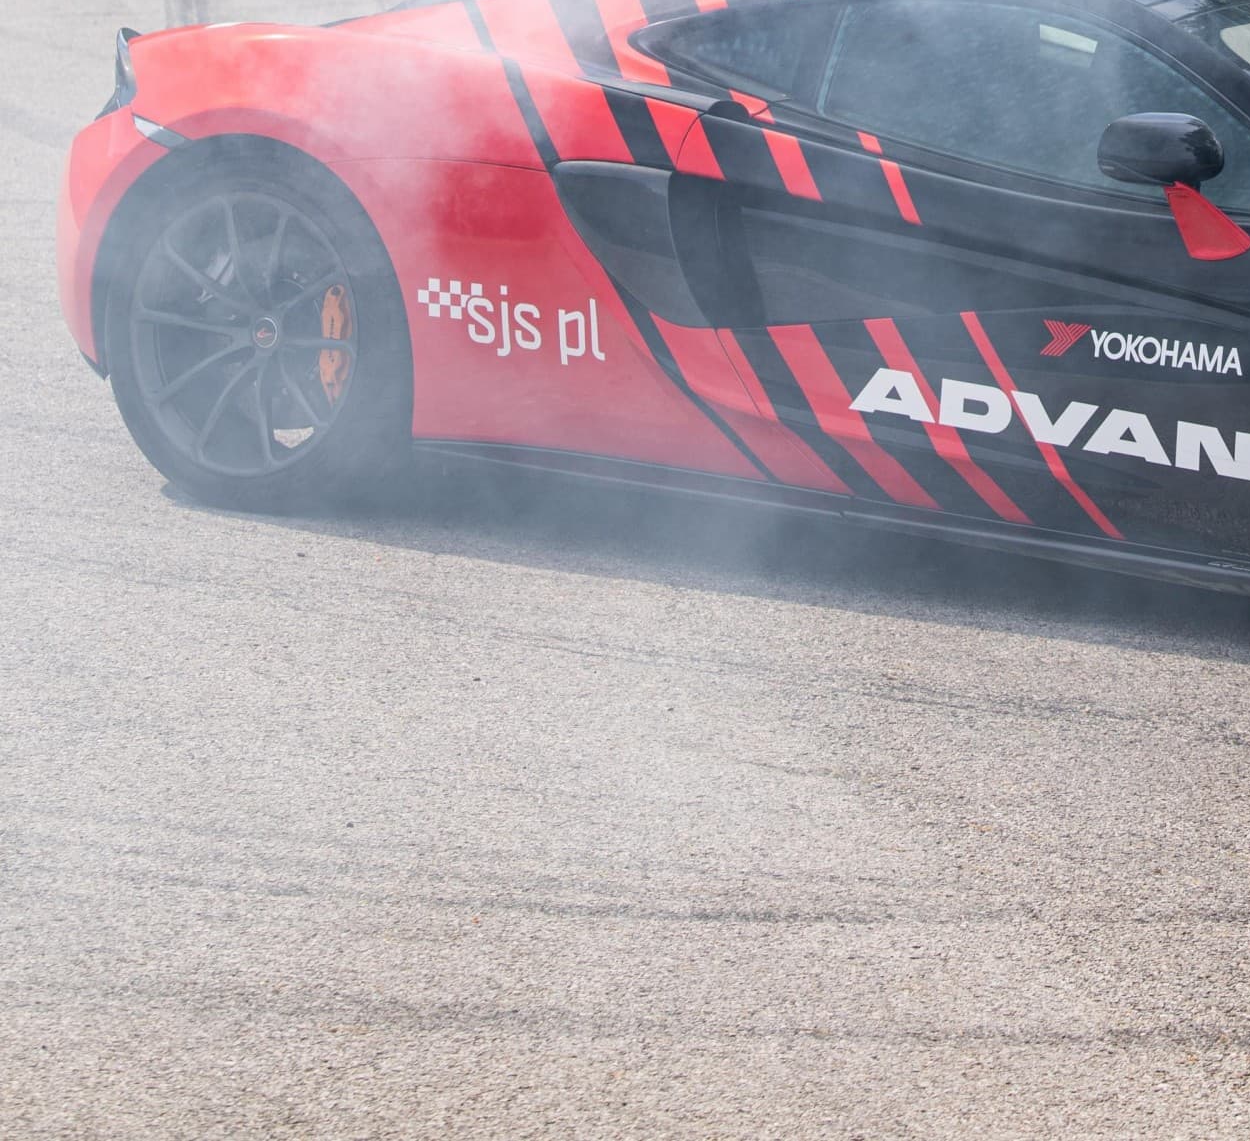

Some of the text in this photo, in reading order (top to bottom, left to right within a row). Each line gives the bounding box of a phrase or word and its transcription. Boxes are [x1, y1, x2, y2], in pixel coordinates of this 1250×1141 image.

[467, 285, 606, 365] sjs pl
[1089, 329, 1243, 376] YOKOHAMA
